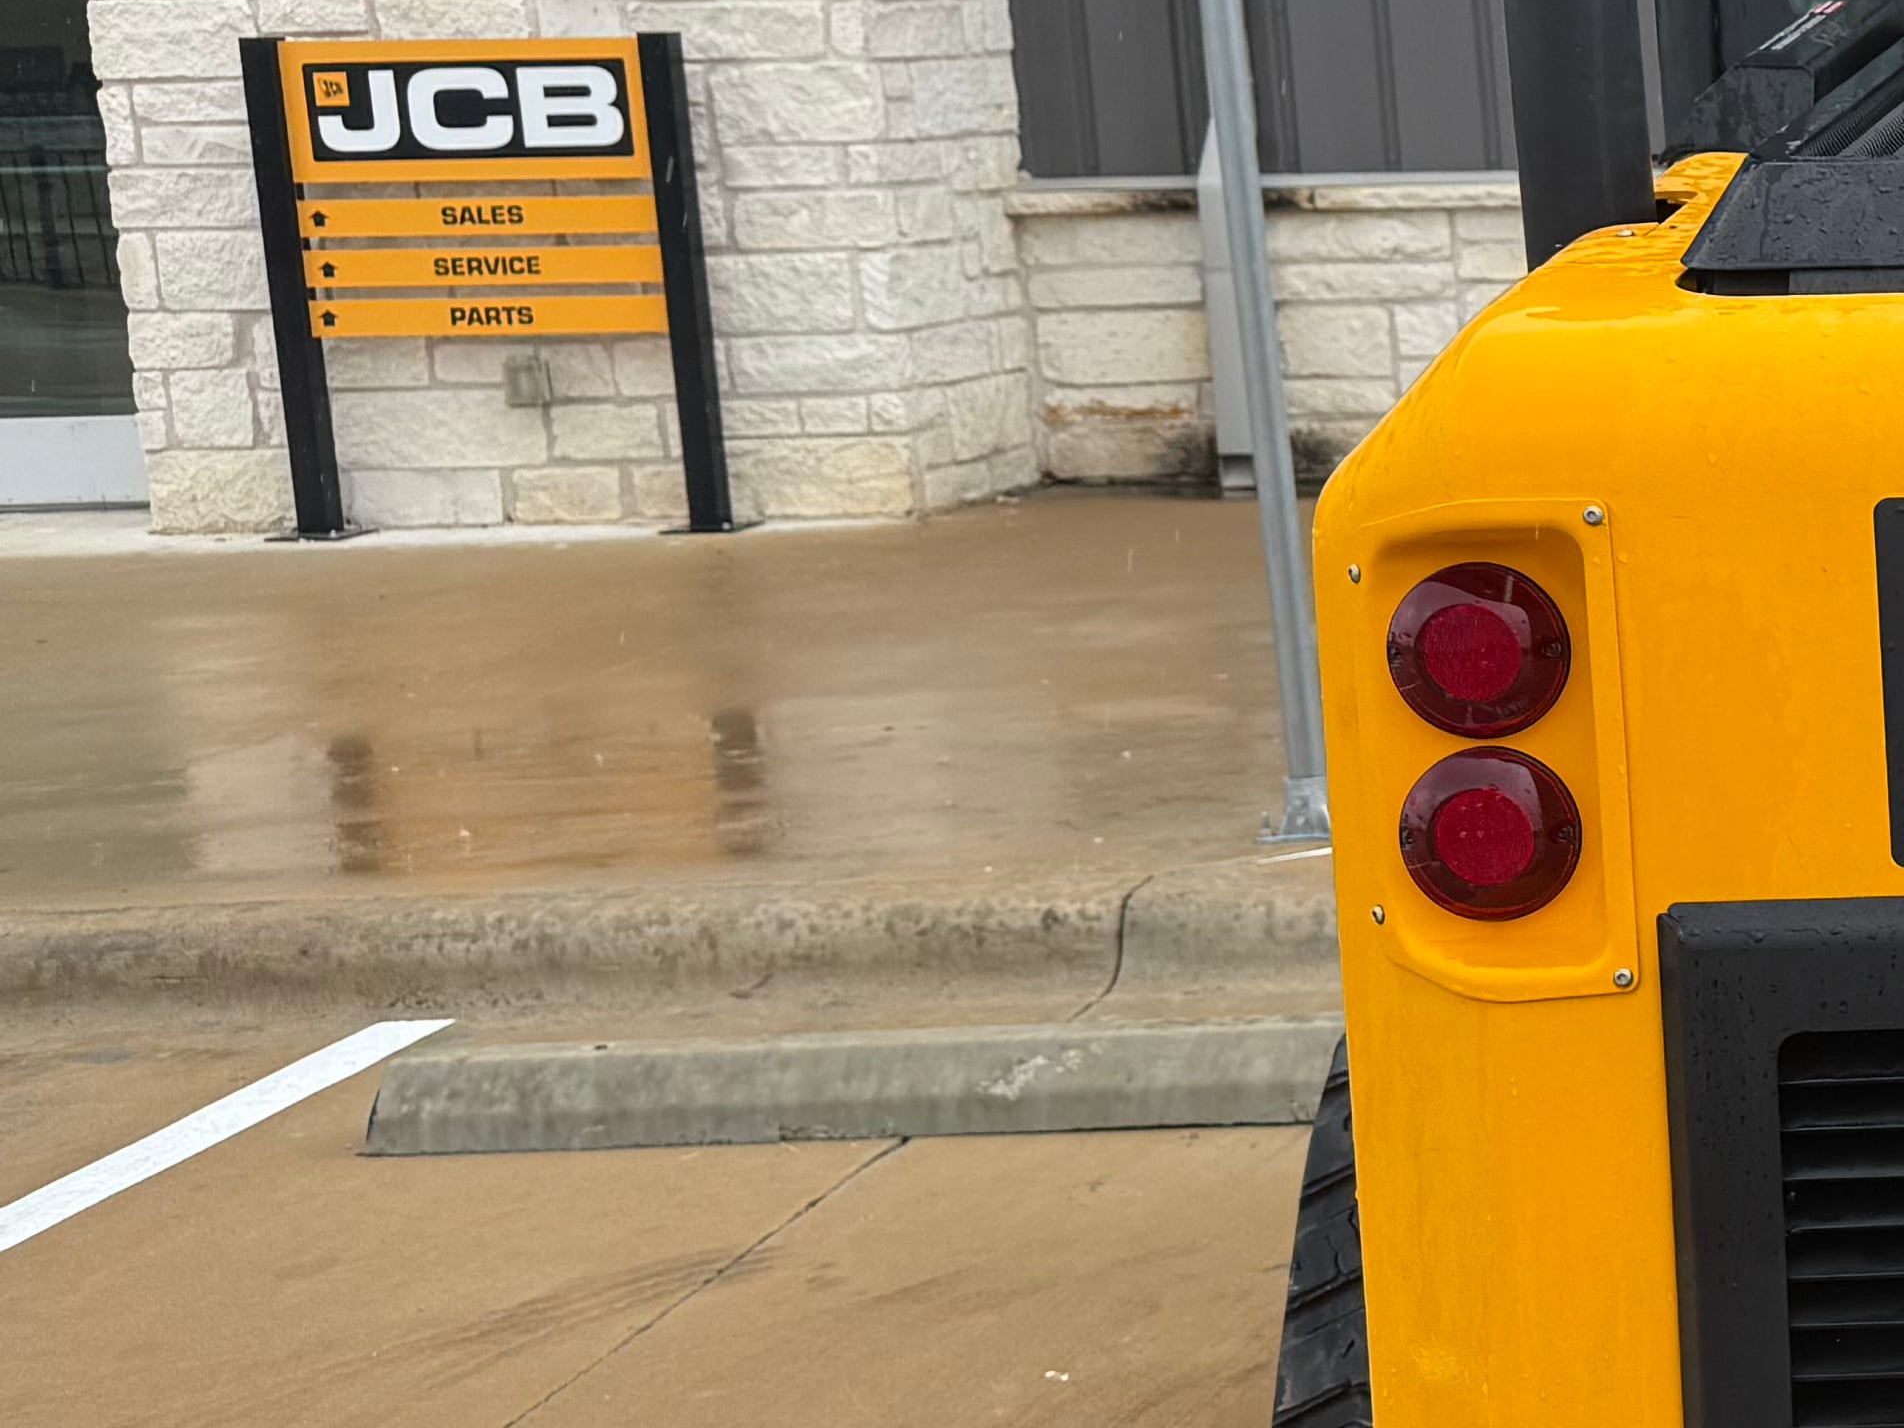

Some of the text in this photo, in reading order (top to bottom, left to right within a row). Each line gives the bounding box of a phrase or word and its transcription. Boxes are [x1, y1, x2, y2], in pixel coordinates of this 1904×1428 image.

[317, 64, 625, 152] JCB
[441, 205, 524, 225] SALES
[434, 256, 541, 276] SERVICE
[450, 306, 534, 327] PARTS
